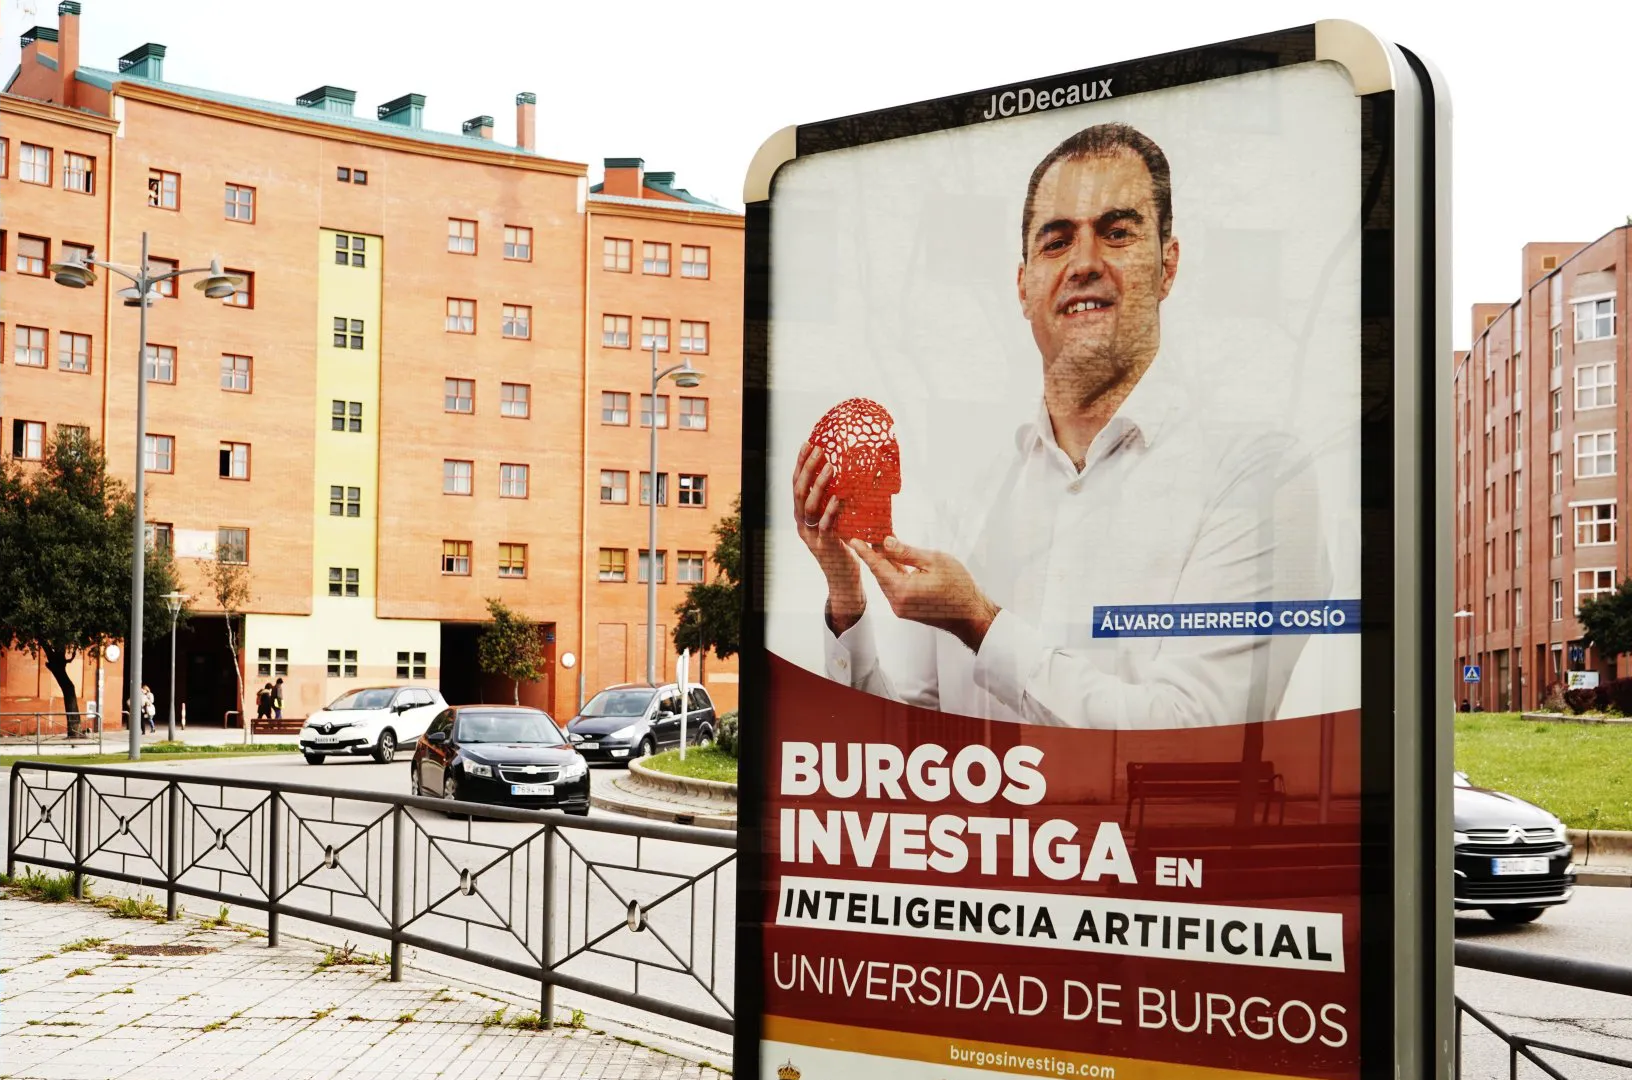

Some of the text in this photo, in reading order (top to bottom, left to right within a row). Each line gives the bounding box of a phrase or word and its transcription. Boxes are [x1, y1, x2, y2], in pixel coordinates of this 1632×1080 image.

[984, 79, 1112, 119] JCDecaux
[1100, 605, 1346, 631] ÁLVARO HERRERO COSÍO
[781, 742, 1046, 805] BURGOS
[780, 809, 1202, 888] INVESTIGA EN
[784, 889, 1332, 961] INTELIGENCIA ARTIFICIAL
[774, 952, 1347, 1047] UNIVERSIDAD DE BURGOS
[951, 1046, 1114, 1078] burgosinvestiga.com
